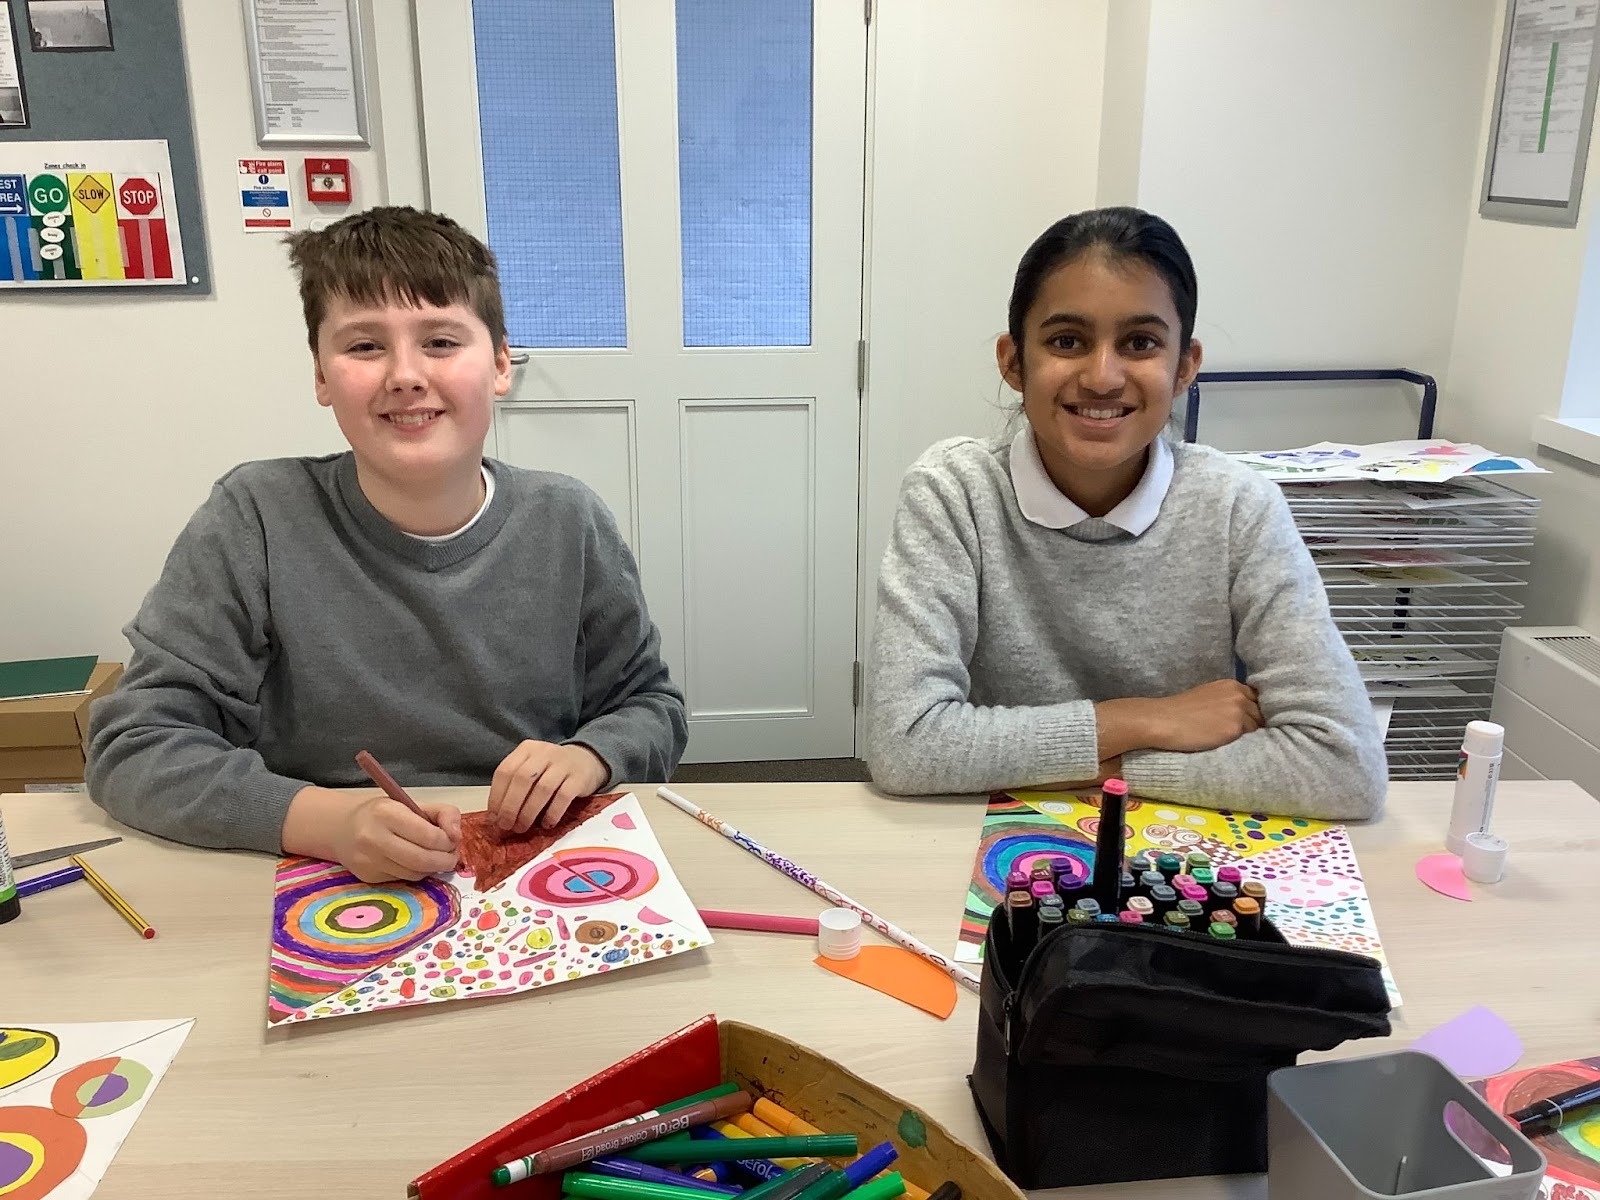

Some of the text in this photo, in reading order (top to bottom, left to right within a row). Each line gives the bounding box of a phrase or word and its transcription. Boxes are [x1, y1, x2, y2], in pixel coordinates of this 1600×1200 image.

[0, 179, 17, 190] EST
[0, 192, 21, 203] REA
[34, 187, 64, 204] GO
[78, 189, 104, 200] SLOW
[122, 190, 154, 205] STOP
[594, 1139, 619, 1156] Broad
